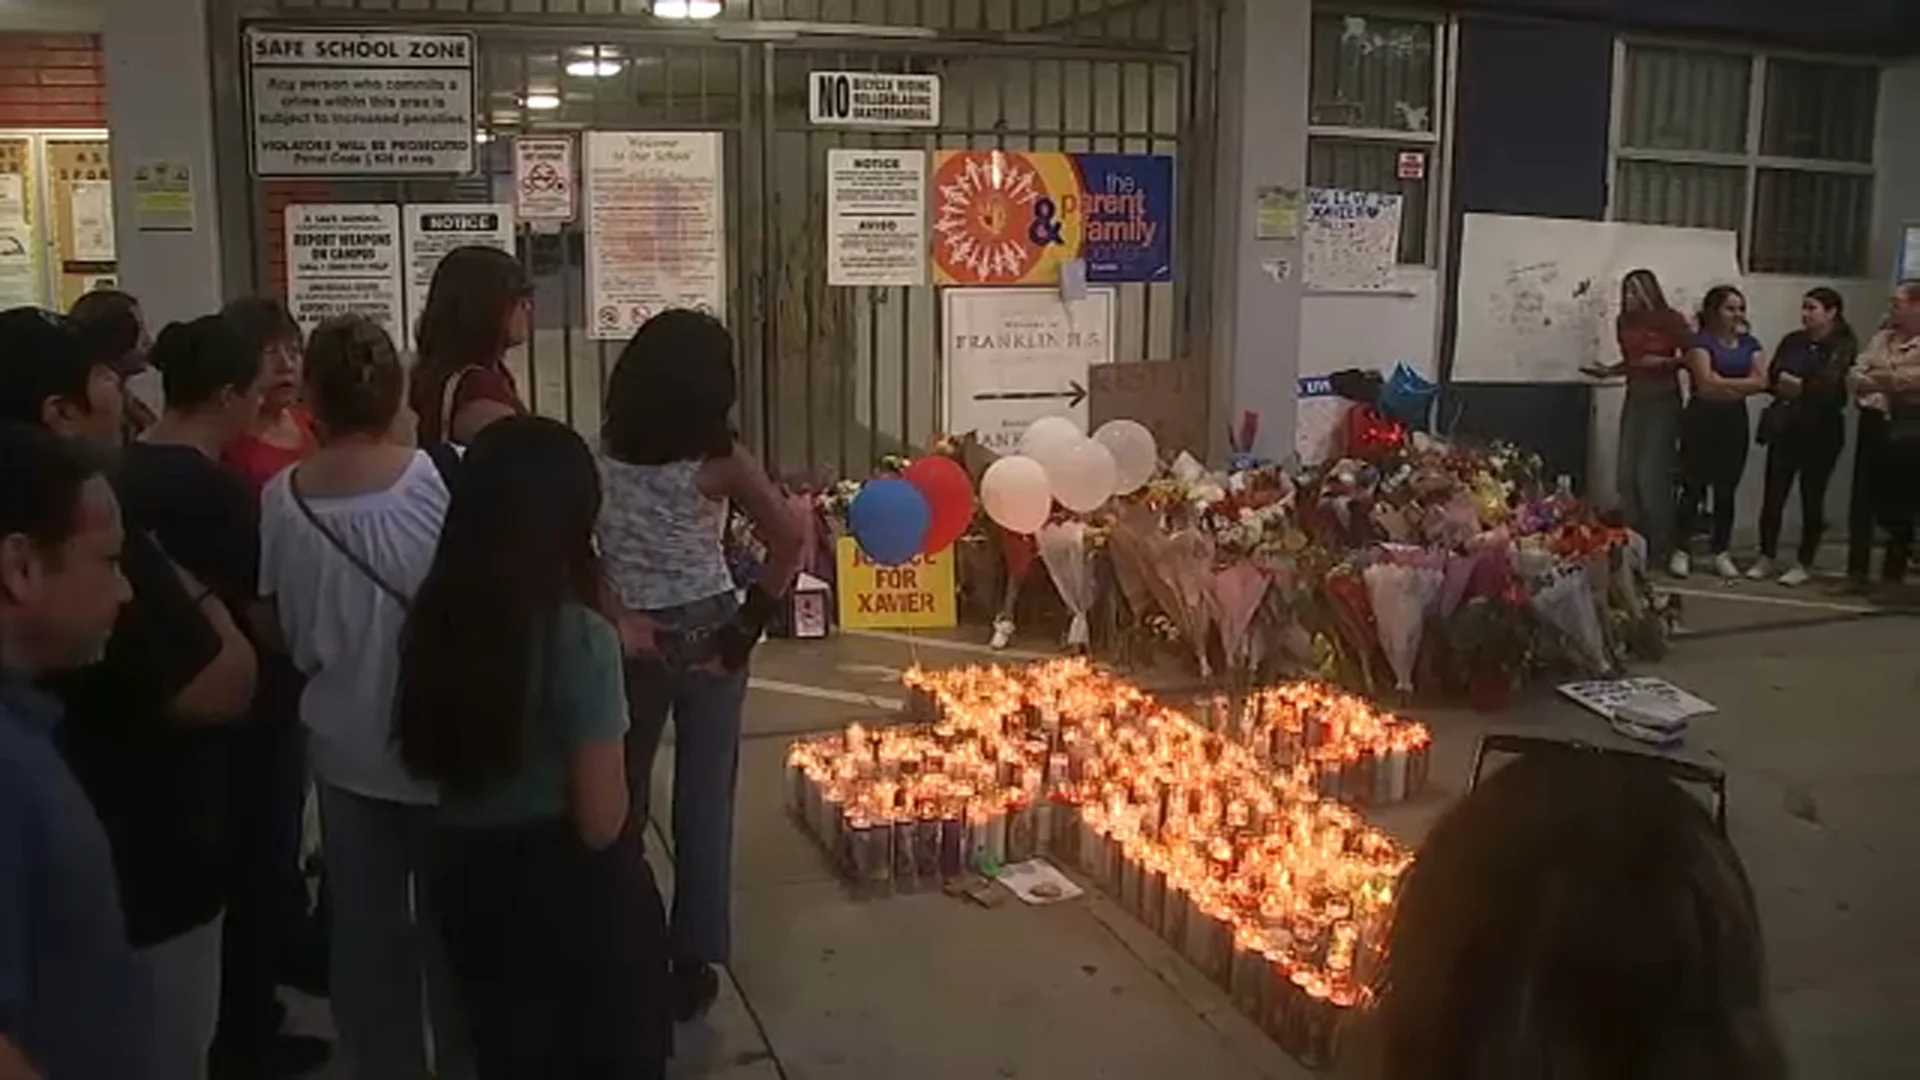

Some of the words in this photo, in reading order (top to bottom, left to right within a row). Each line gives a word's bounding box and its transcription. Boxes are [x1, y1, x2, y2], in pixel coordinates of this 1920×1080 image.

[255, 38, 304, 58] SAFE
[315, 39, 400, 59] SCHOOL
[408, 41, 466, 59] ZONE
[353, 78, 382, 91] who
[818, 75, 849, 118] NO
[1106, 173, 1135, 192] the
[1061, 189, 1146, 219] parent
[429, 215, 490, 230] NOTICE
[1082, 214, 1156, 248] family
[293, 233, 336, 247] REPORT
[339, 234, 392, 247] WEAPONS
[330, 247, 376, 261] CAMPUS
[955, 334, 1058, 349] FRANKLIN
[875, 569, 917, 589] FOR
[857, 592, 936, 613] XAVIER
